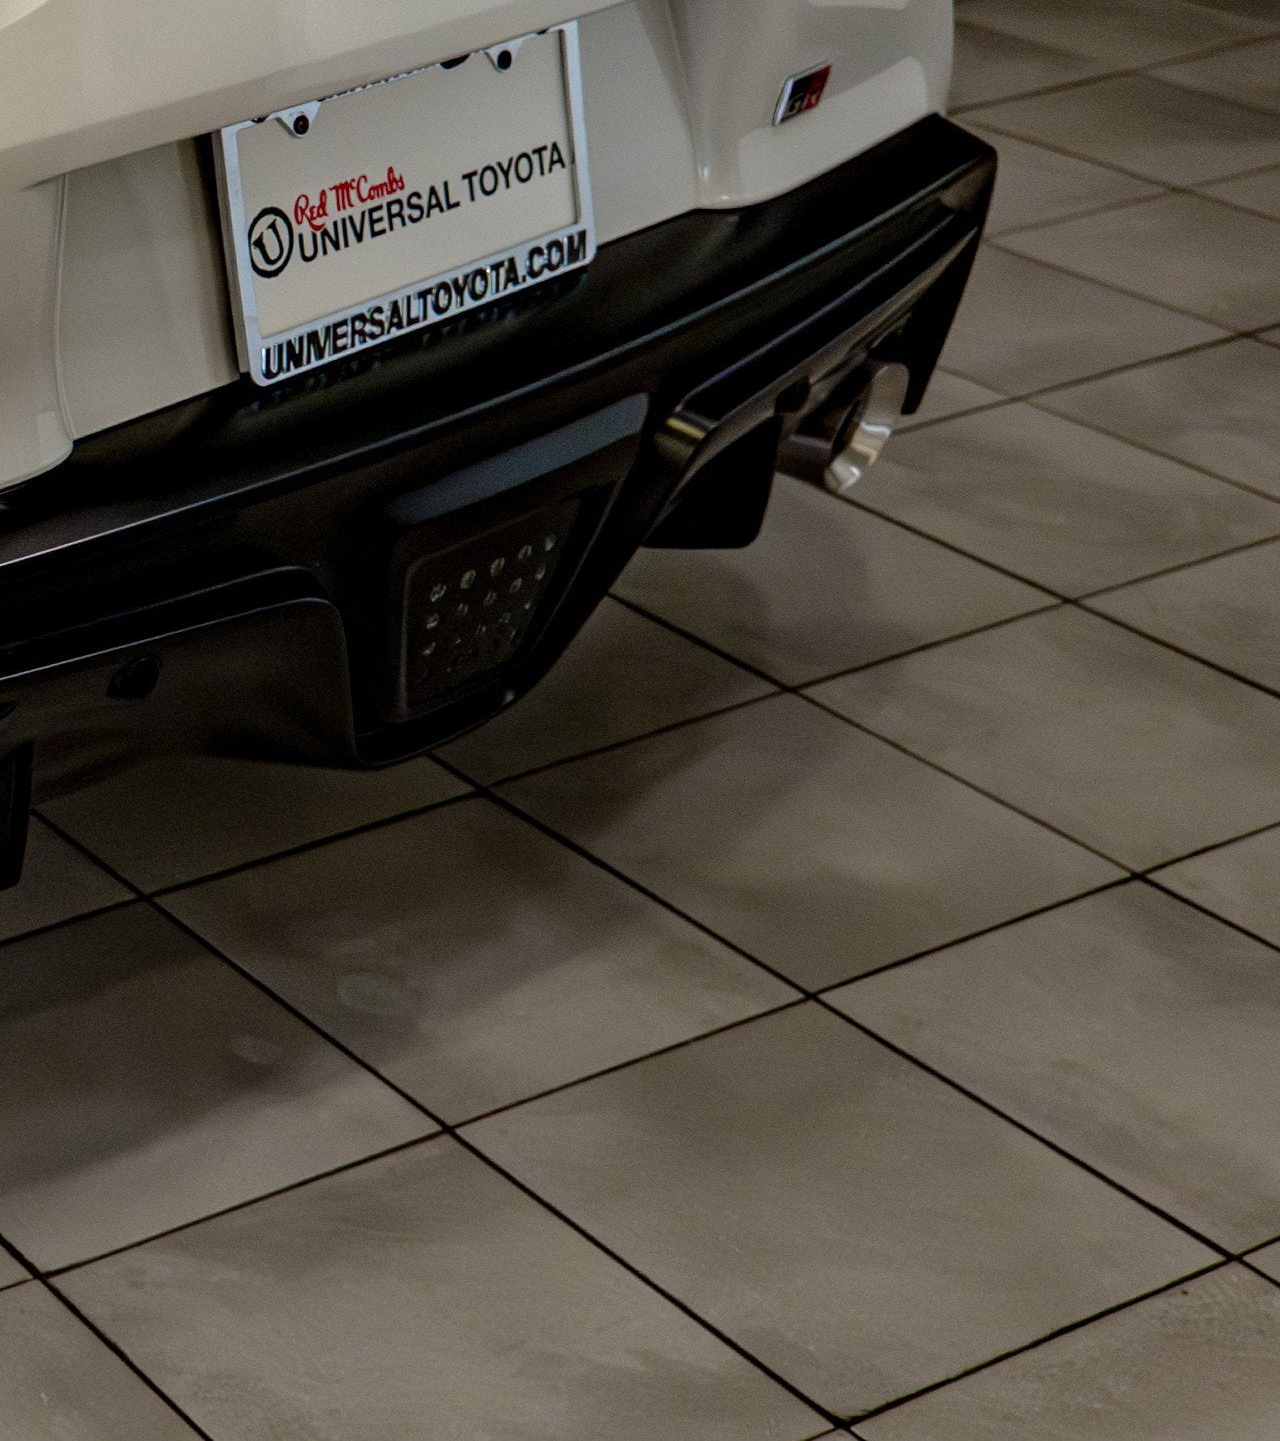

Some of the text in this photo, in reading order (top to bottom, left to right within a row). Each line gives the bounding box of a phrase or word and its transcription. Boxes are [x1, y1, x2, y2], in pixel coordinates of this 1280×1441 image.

[293, 189, 329, 231] Red
[298, 141, 566, 263] UNIVERSAL TOYOTA
[261, 229, 588, 379] UNIVERSALTOYOTA.COM
